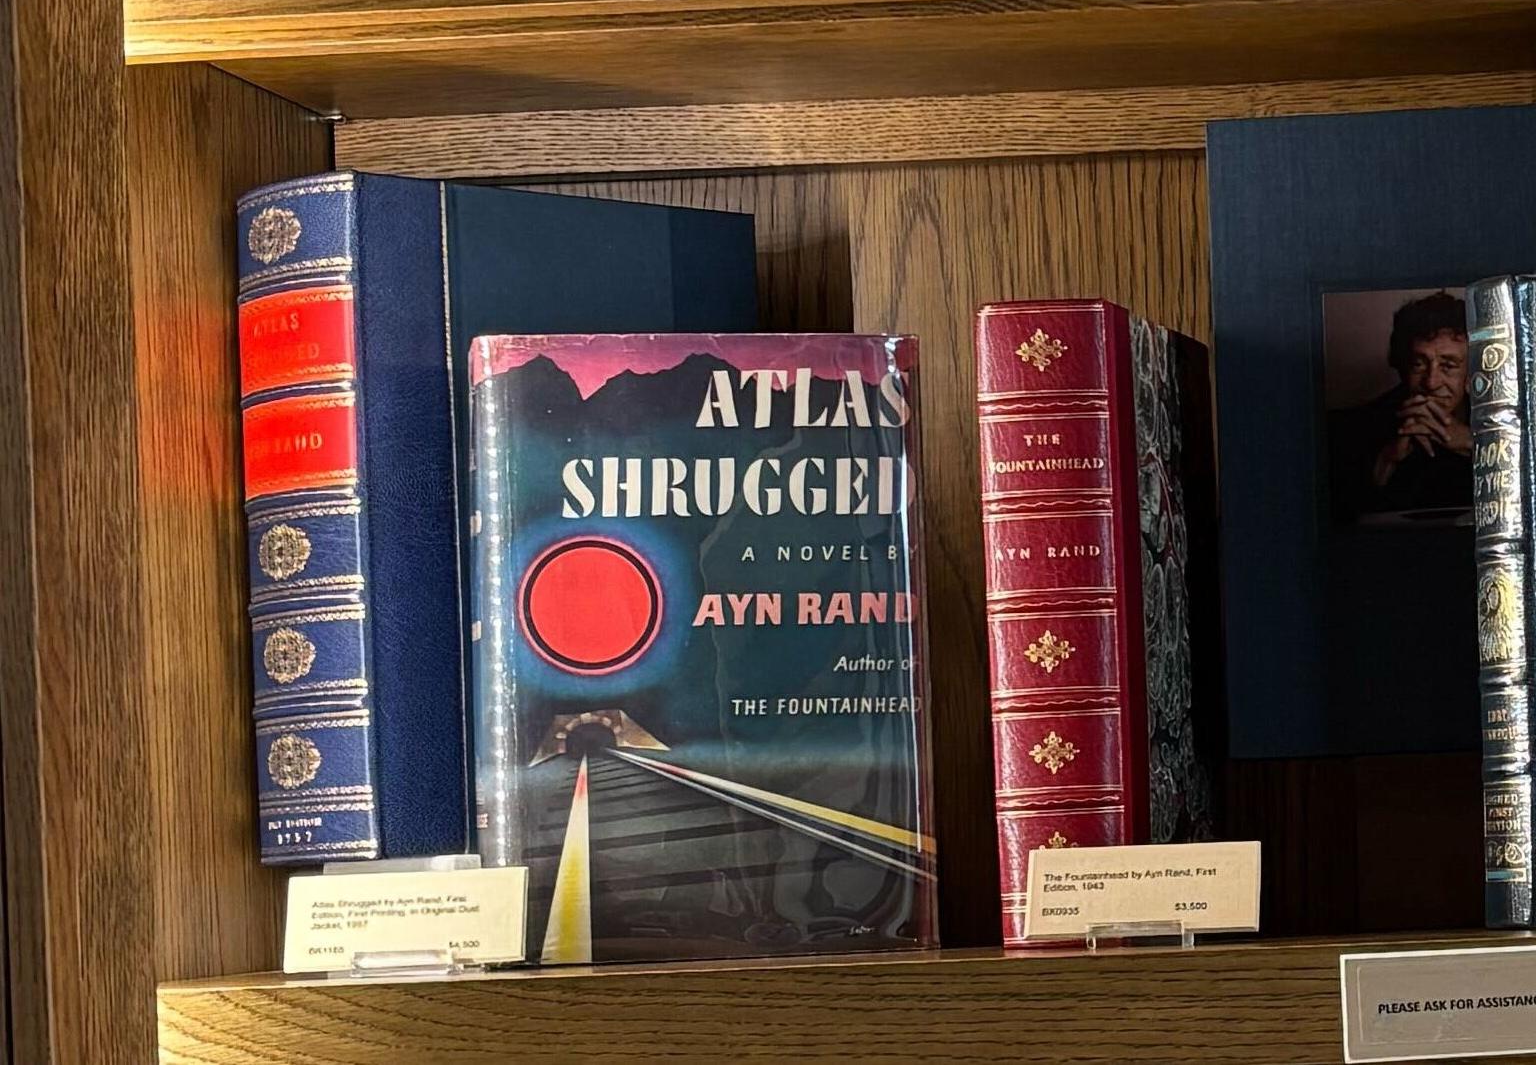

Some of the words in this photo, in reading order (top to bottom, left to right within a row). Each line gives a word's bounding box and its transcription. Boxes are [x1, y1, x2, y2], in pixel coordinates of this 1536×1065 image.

[695, 367, 912, 429] ATLAS
[1024, 434, 1061, 447] THE
[989, 458, 1104, 473] FOUNTAINHEAD
[561, 456, 917, 518] SHRUGGED
[741, 546, 755, 561] A
[778, 545, 869, 562] NOVEL
[995, 548, 1030, 561] AYN
[1047, 545, 1101, 558] RAND
[692, 593, 782, 627] AYN
[797, 591, 920, 625] RAND
[834, 654, 894, 672] Author
[731, 699, 767, 716] THE
[775, 696, 922, 715] FOUNTAINHEAD
[1044, 874, 1062, 882] The
[1131, 870, 1142, 880] by
[1144, 869, 1163, 879] Ayn
[1195, 867, 1216, 876] First
[1378, 1001, 1420, 1014] PLEASE
[1423, 1000, 1447, 1011] ASK
[1450, 998, 1474, 1010] FOR
